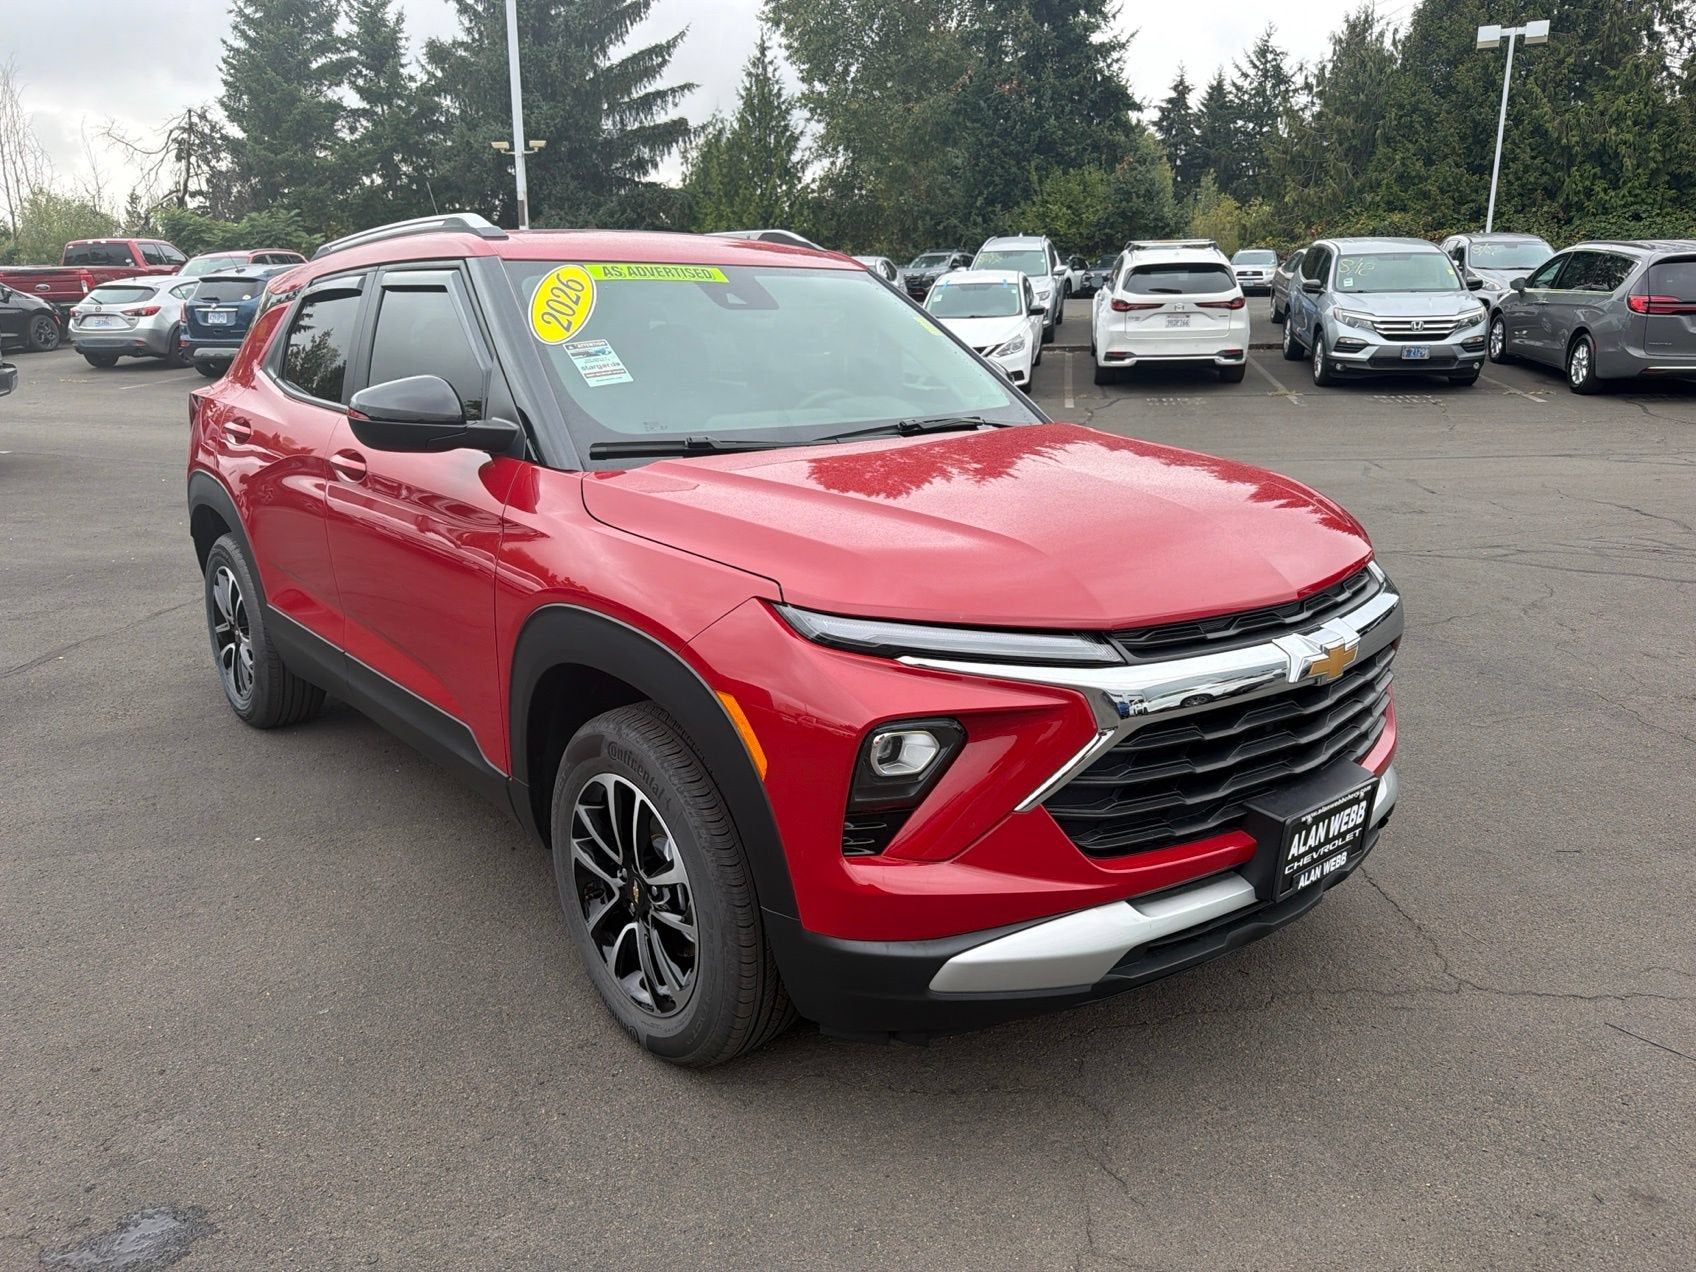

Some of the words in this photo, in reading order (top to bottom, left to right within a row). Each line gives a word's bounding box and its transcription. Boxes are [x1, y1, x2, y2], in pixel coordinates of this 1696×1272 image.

[603, 265, 623, 280] AS
[628, 266, 713, 280] ADVERTISED
[541, 273, 585, 333] 2026
[607, 741, 665, 800] Continental
[1285, 827, 1363, 875] CHEVROLET
[1288, 819, 1329, 860] ALAN
[1329, 800, 1367, 839] WEBB
[1298, 864, 1322, 890] ALAN
[1323, 851, 1348, 875] WEBB
